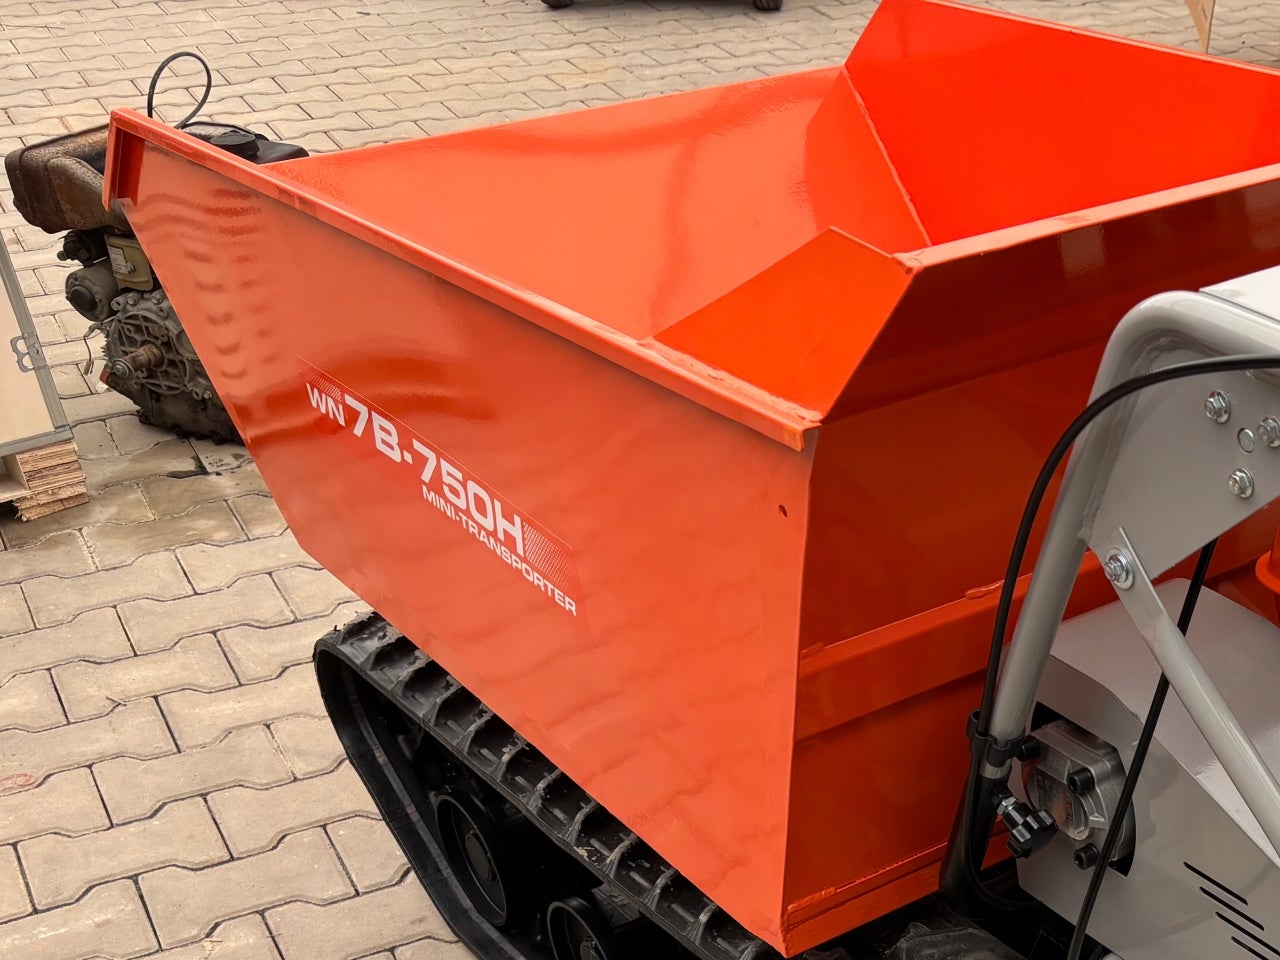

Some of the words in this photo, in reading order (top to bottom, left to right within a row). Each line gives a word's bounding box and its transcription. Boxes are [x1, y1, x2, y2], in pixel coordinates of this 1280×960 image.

[306, 382, 346, 427] WN
[344, 393, 525, 558] 7B-750H
[422, 484, 577, 617] MINI-TRANSPORTER
